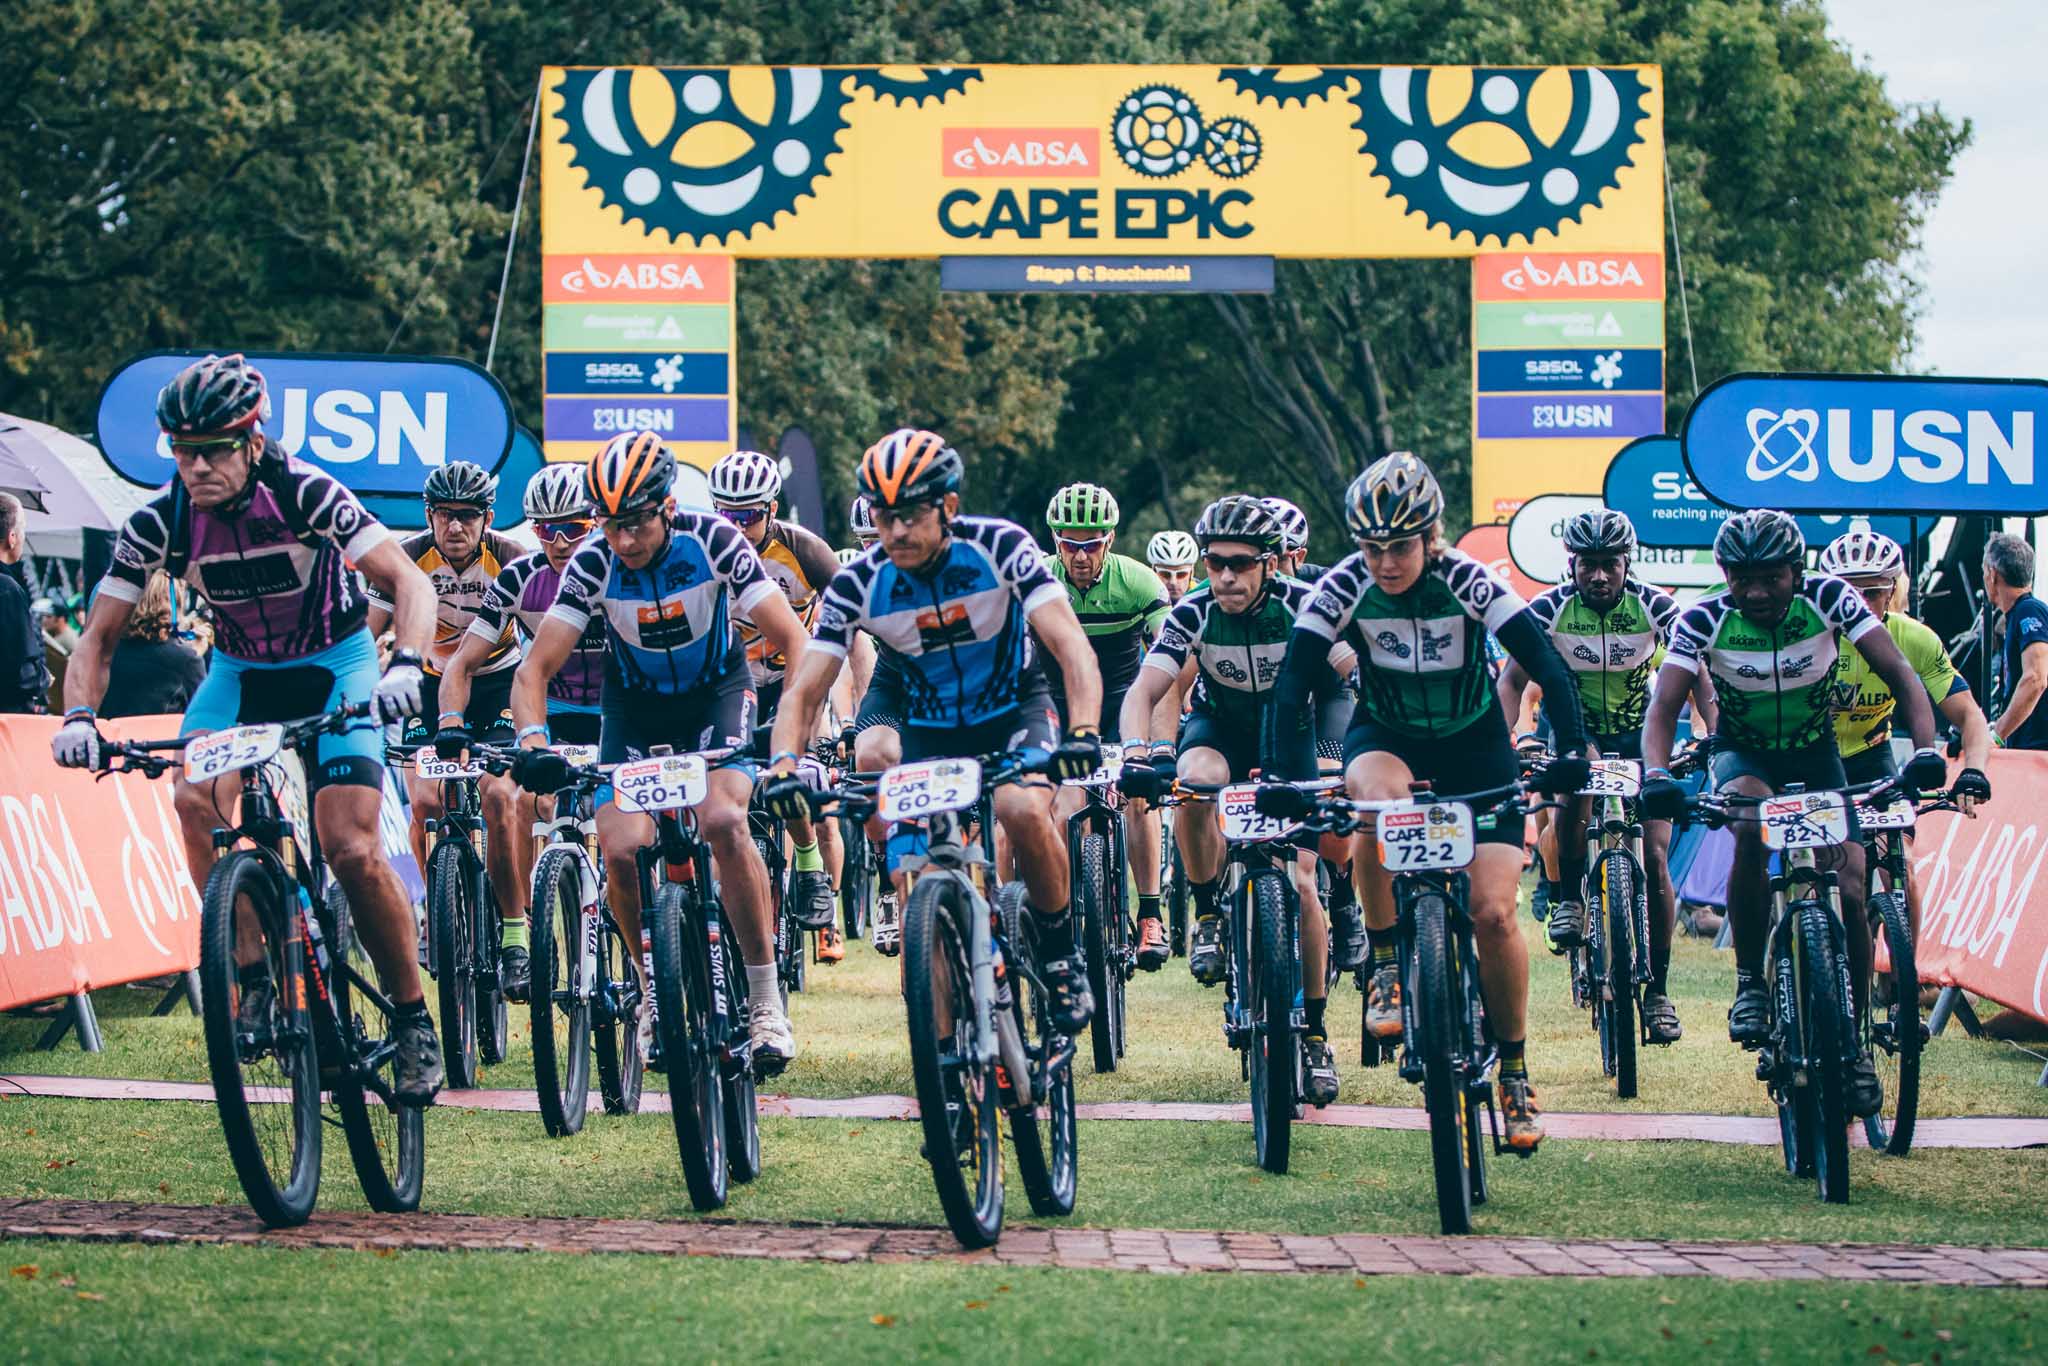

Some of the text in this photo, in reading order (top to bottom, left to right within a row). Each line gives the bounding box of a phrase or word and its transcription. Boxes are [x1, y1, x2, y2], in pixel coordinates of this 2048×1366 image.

[1002, 141, 1089, 166] ABSA
[938, 188, 1255, 239] CAPE EPIC
[612, 263, 704, 289] ABSA
[1026, 264, 1074, 284] Stage
[1552, 260, 1644, 286] ABSA
[615, 408, 674, 431] USN
[1555, 404, 1613, 428] USN
[1827, 408, 2035, 485] USN
[1652, 507, 1707, 522] reaching
[405, 727, 428, 742] FNB
[203, 745, 259, 774] 67-2
[328, 765, 352, 778] RD
[620, 774, 661, 789] CAPE
[635, 784, 688, 805] 60-1
[887, 781, 929, 798] CAPE
[897, 788, 958, 813] 60-2
[1225, 804, 1257, 817] CAP
[1240, 816, 1285, 834] 72-1
[1384, 825, 1466, 843] CAPE EPIC
[1784, 824, 1828, 844] 82-1
[1398, 843, 1454, 864] 72-2
[0, 793, 113, 956] ABSA
[1925, 818, 2048, 969] ABSA
[588, 912, 598, 958] FOX
[707, 943, 729, 1016] DT SWISS
[647, 979, 660, 1023] SWISS
